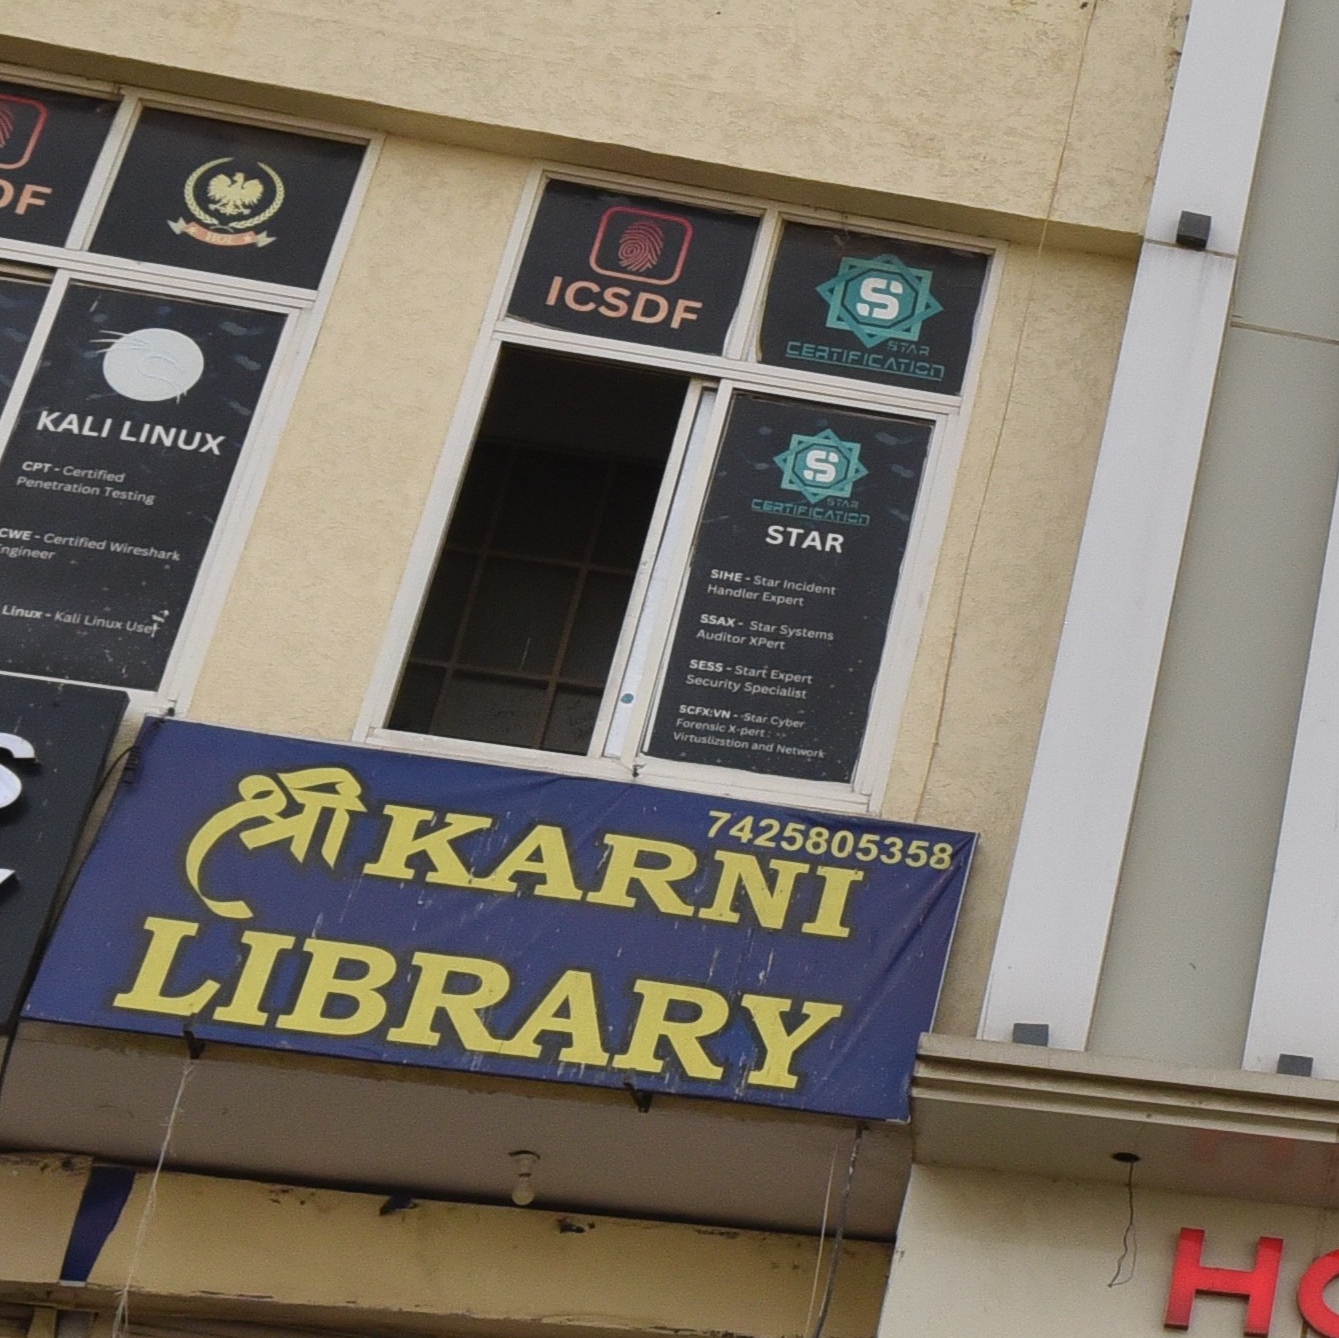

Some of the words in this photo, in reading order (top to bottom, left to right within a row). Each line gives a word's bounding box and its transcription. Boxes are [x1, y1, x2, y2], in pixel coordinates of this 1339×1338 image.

[545, 276, 702, 330] ICSDF
[888, 340, 930, 357] STAR
[37, 411, 112, 438] KALI
[120, 421, 226, 456] LINUX
[22, 461, 52, 473] CPT
[63, 466, 126, 483] Certified
[17, 476, 100, 495] Penetration
[104, 487, 156, 505] Testing
[43, 533, 107, 550] Certified
[110, 542, 181, 561] Wireshark
[765, 525, 845, 553] STAR
[707, 584, 759, 600] Handler
[762, 591, 804, 607] Expert
[710, 569, 743, 583] SIHE
[753, 575, 780, 588] Star
[783, 580, 836, 596] Incident
[54, 611, 81, 624] Kali
[84, 615, 122, 630] Linux
[700, 614, 736, 628] SSAX
[750, 621, 776, 634] Star
[779, 625, 834, 641] Systems
[696, 629, 745, 645] Auditor
[749, 636, 786, 651] XPert
[689, 659, 723, 673] SESS
[734, 664, 767, 678] Start
[770, 669, 813, 685] Expert
[685, 675, 741, 693] Security
[744, 681, 807, 699] Specialist
[676, 718, 725, 733] Forensic
[728, 724, 765, 738] X-pert
[770, 716, 805, 729] Cyber
[751, 742, 774, 753] and
[776, 744, 826, 759] Network
[186, 766, 367, 919] श्री
[707, 810, 953, 870] 7425805358
[363, 803, 865, 939] KARNI
[113, 916, 842, 1090] LIBRARY
